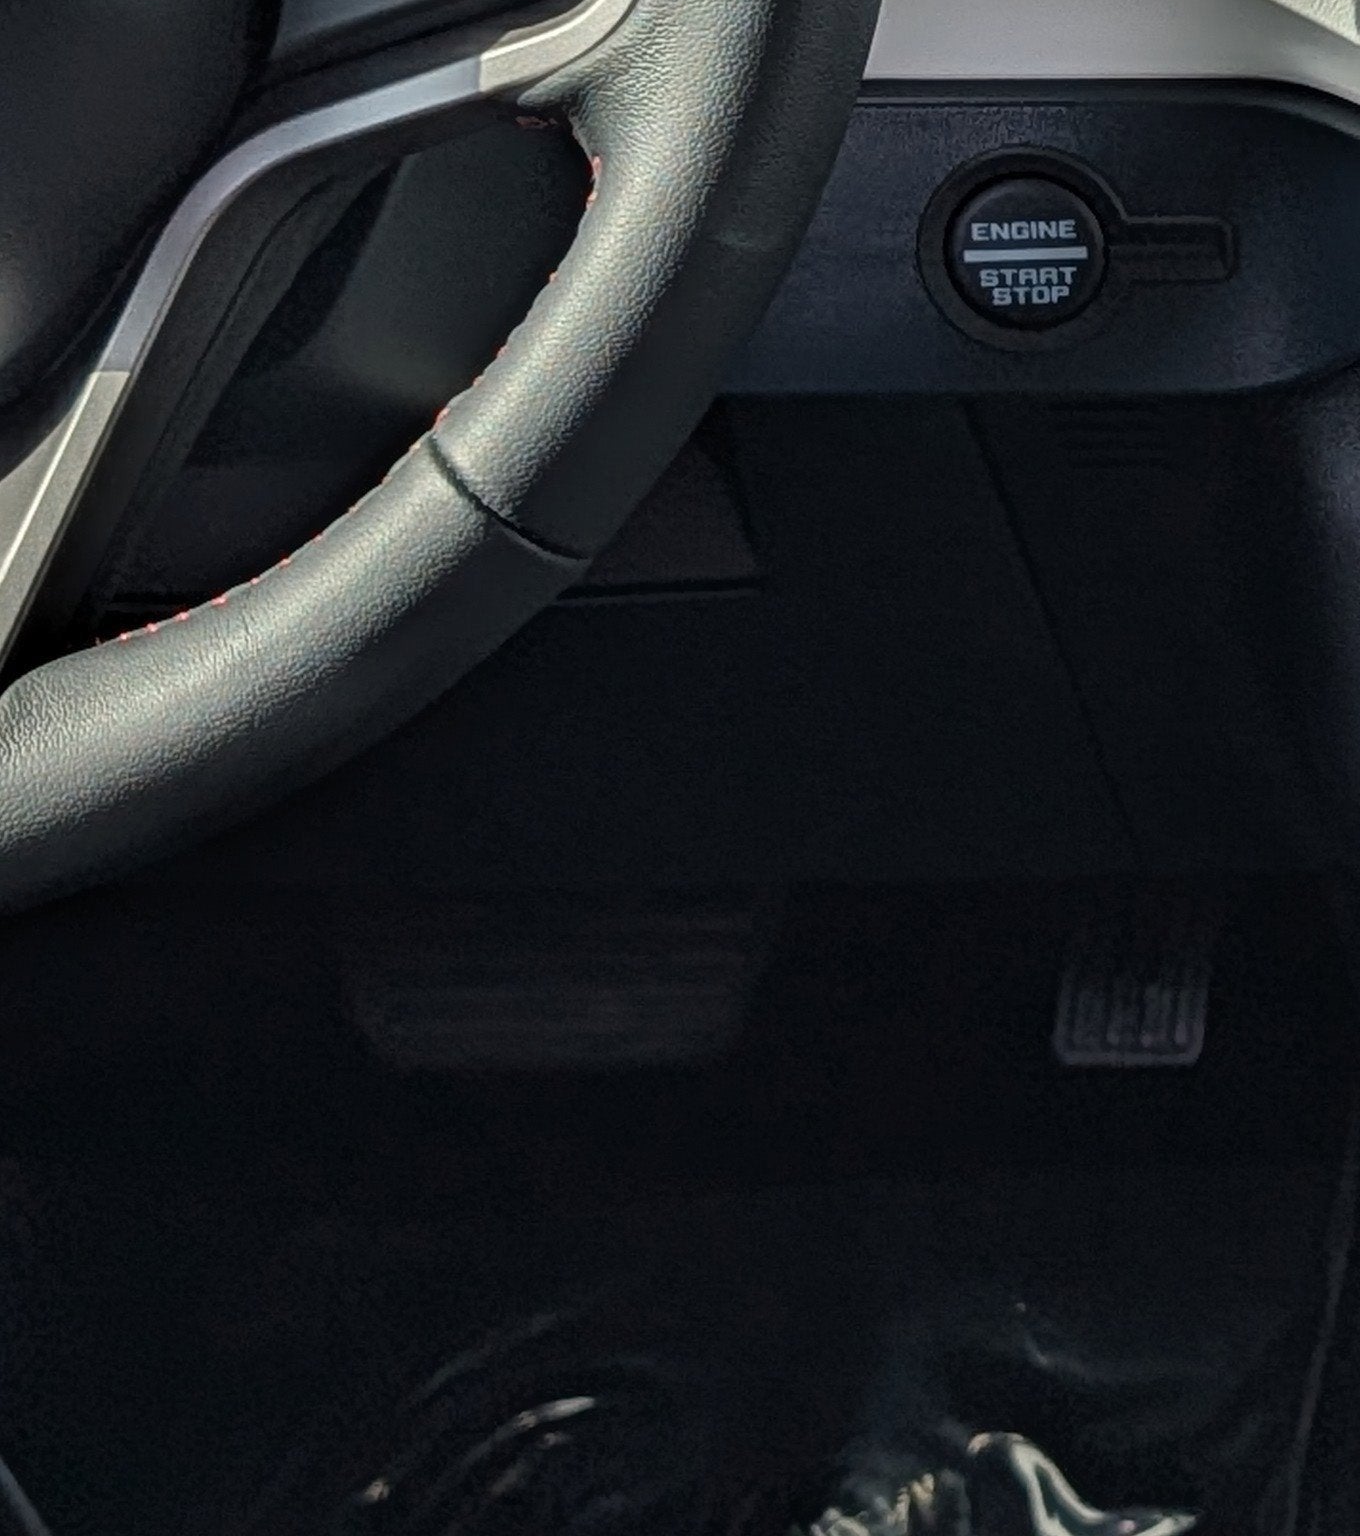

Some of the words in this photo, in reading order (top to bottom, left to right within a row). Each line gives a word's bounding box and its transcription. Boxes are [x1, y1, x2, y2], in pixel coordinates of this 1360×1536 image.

[971, 219, 1077, 241] ENGINE
[980, 267, 1077, 287] START
[993, 285, 1070, 306] STOP
